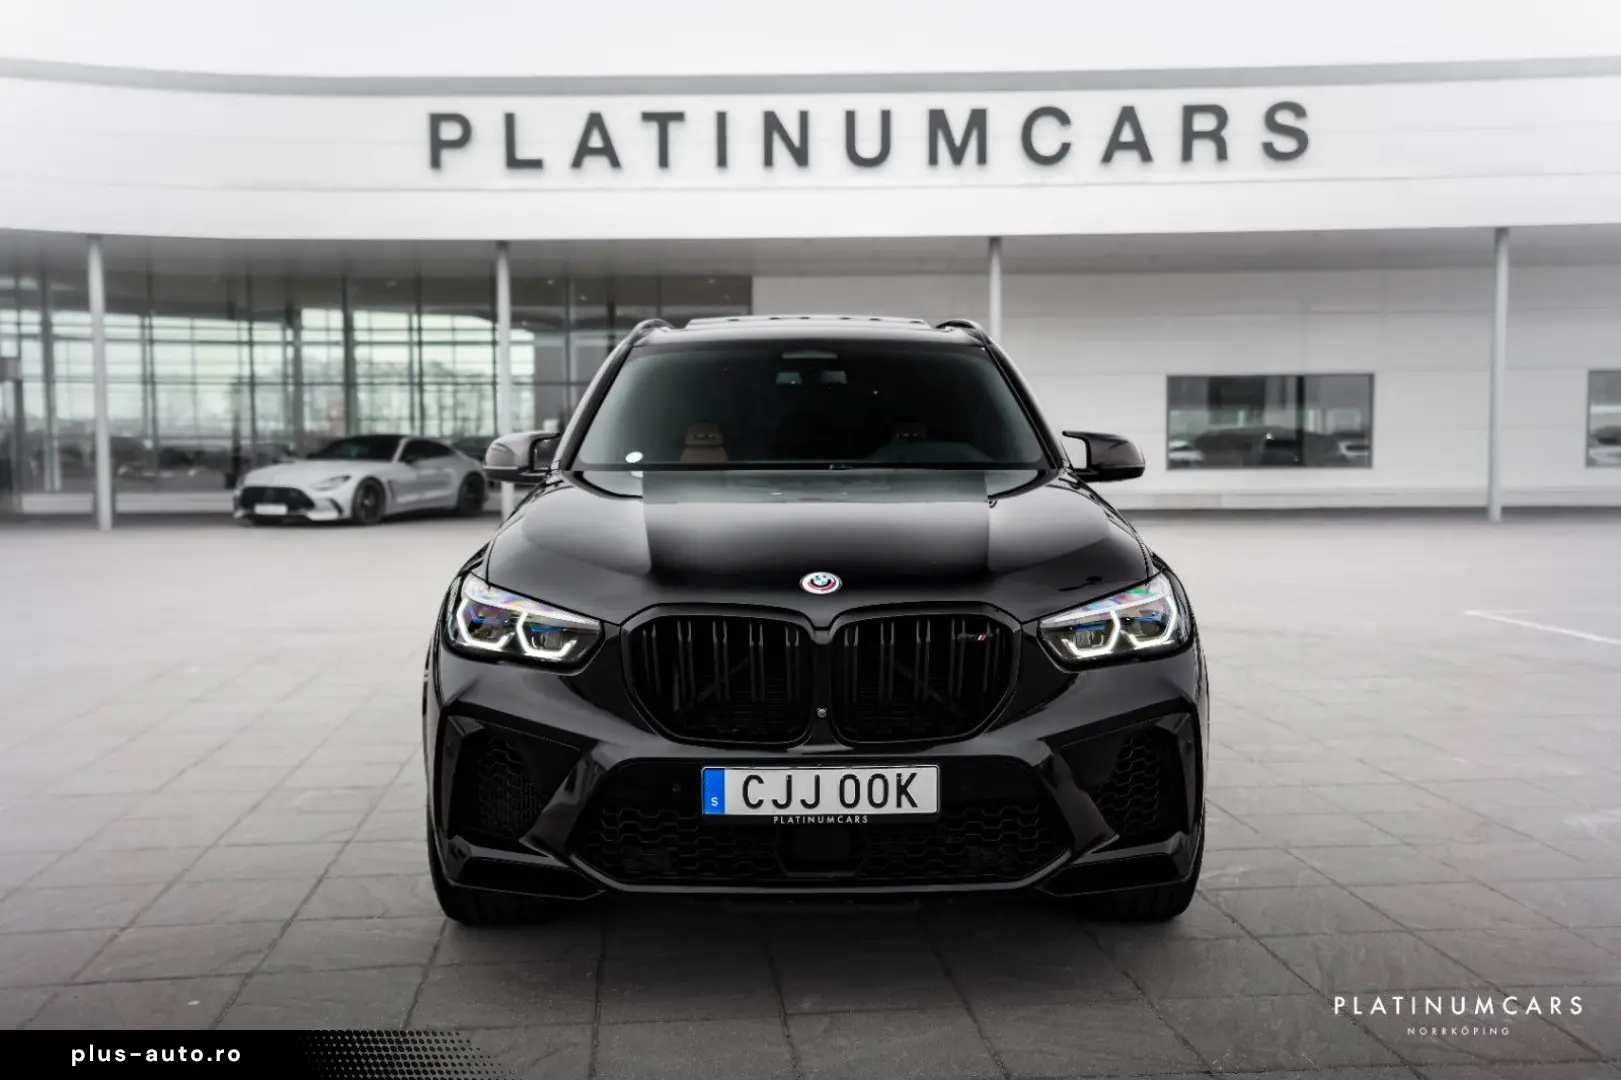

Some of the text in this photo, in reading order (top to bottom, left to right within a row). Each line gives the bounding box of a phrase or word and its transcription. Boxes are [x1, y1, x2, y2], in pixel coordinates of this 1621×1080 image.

[428, 101, 1311, 170] PLATINUMCARS
[710, 796, 719, 807] S
[742, 774, 821, 810] CJJ
[773, 815, 868, 824] PLATINUMCARS
